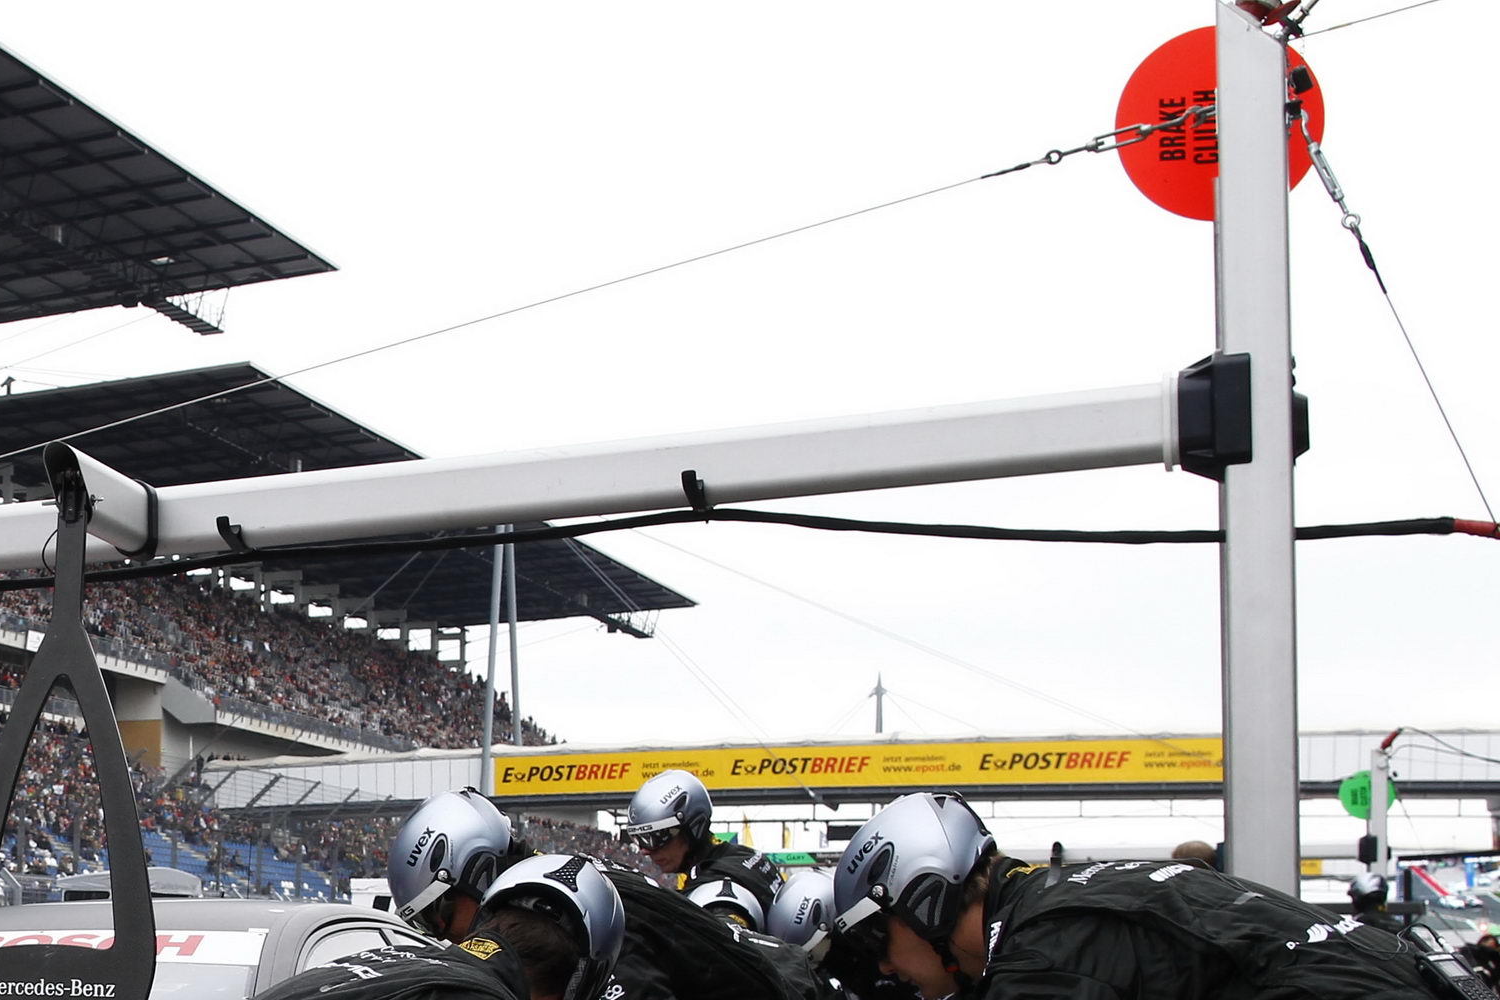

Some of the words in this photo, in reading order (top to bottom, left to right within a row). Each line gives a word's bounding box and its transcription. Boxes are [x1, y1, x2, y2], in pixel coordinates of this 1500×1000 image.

[1159, 96, 1186, 161] BRAKE
[1193, 89, 1219, 164] CLUH
[882, 763, 963, 774] www.epost.de
[1144, 758, 1223, 769] www.epost.d
[659, 784, 683, 806] uvex
[405, 825, 437, 869] uvex
[846, 831, 885, 875] uvex
[793, 896, 812, 926] uvex
